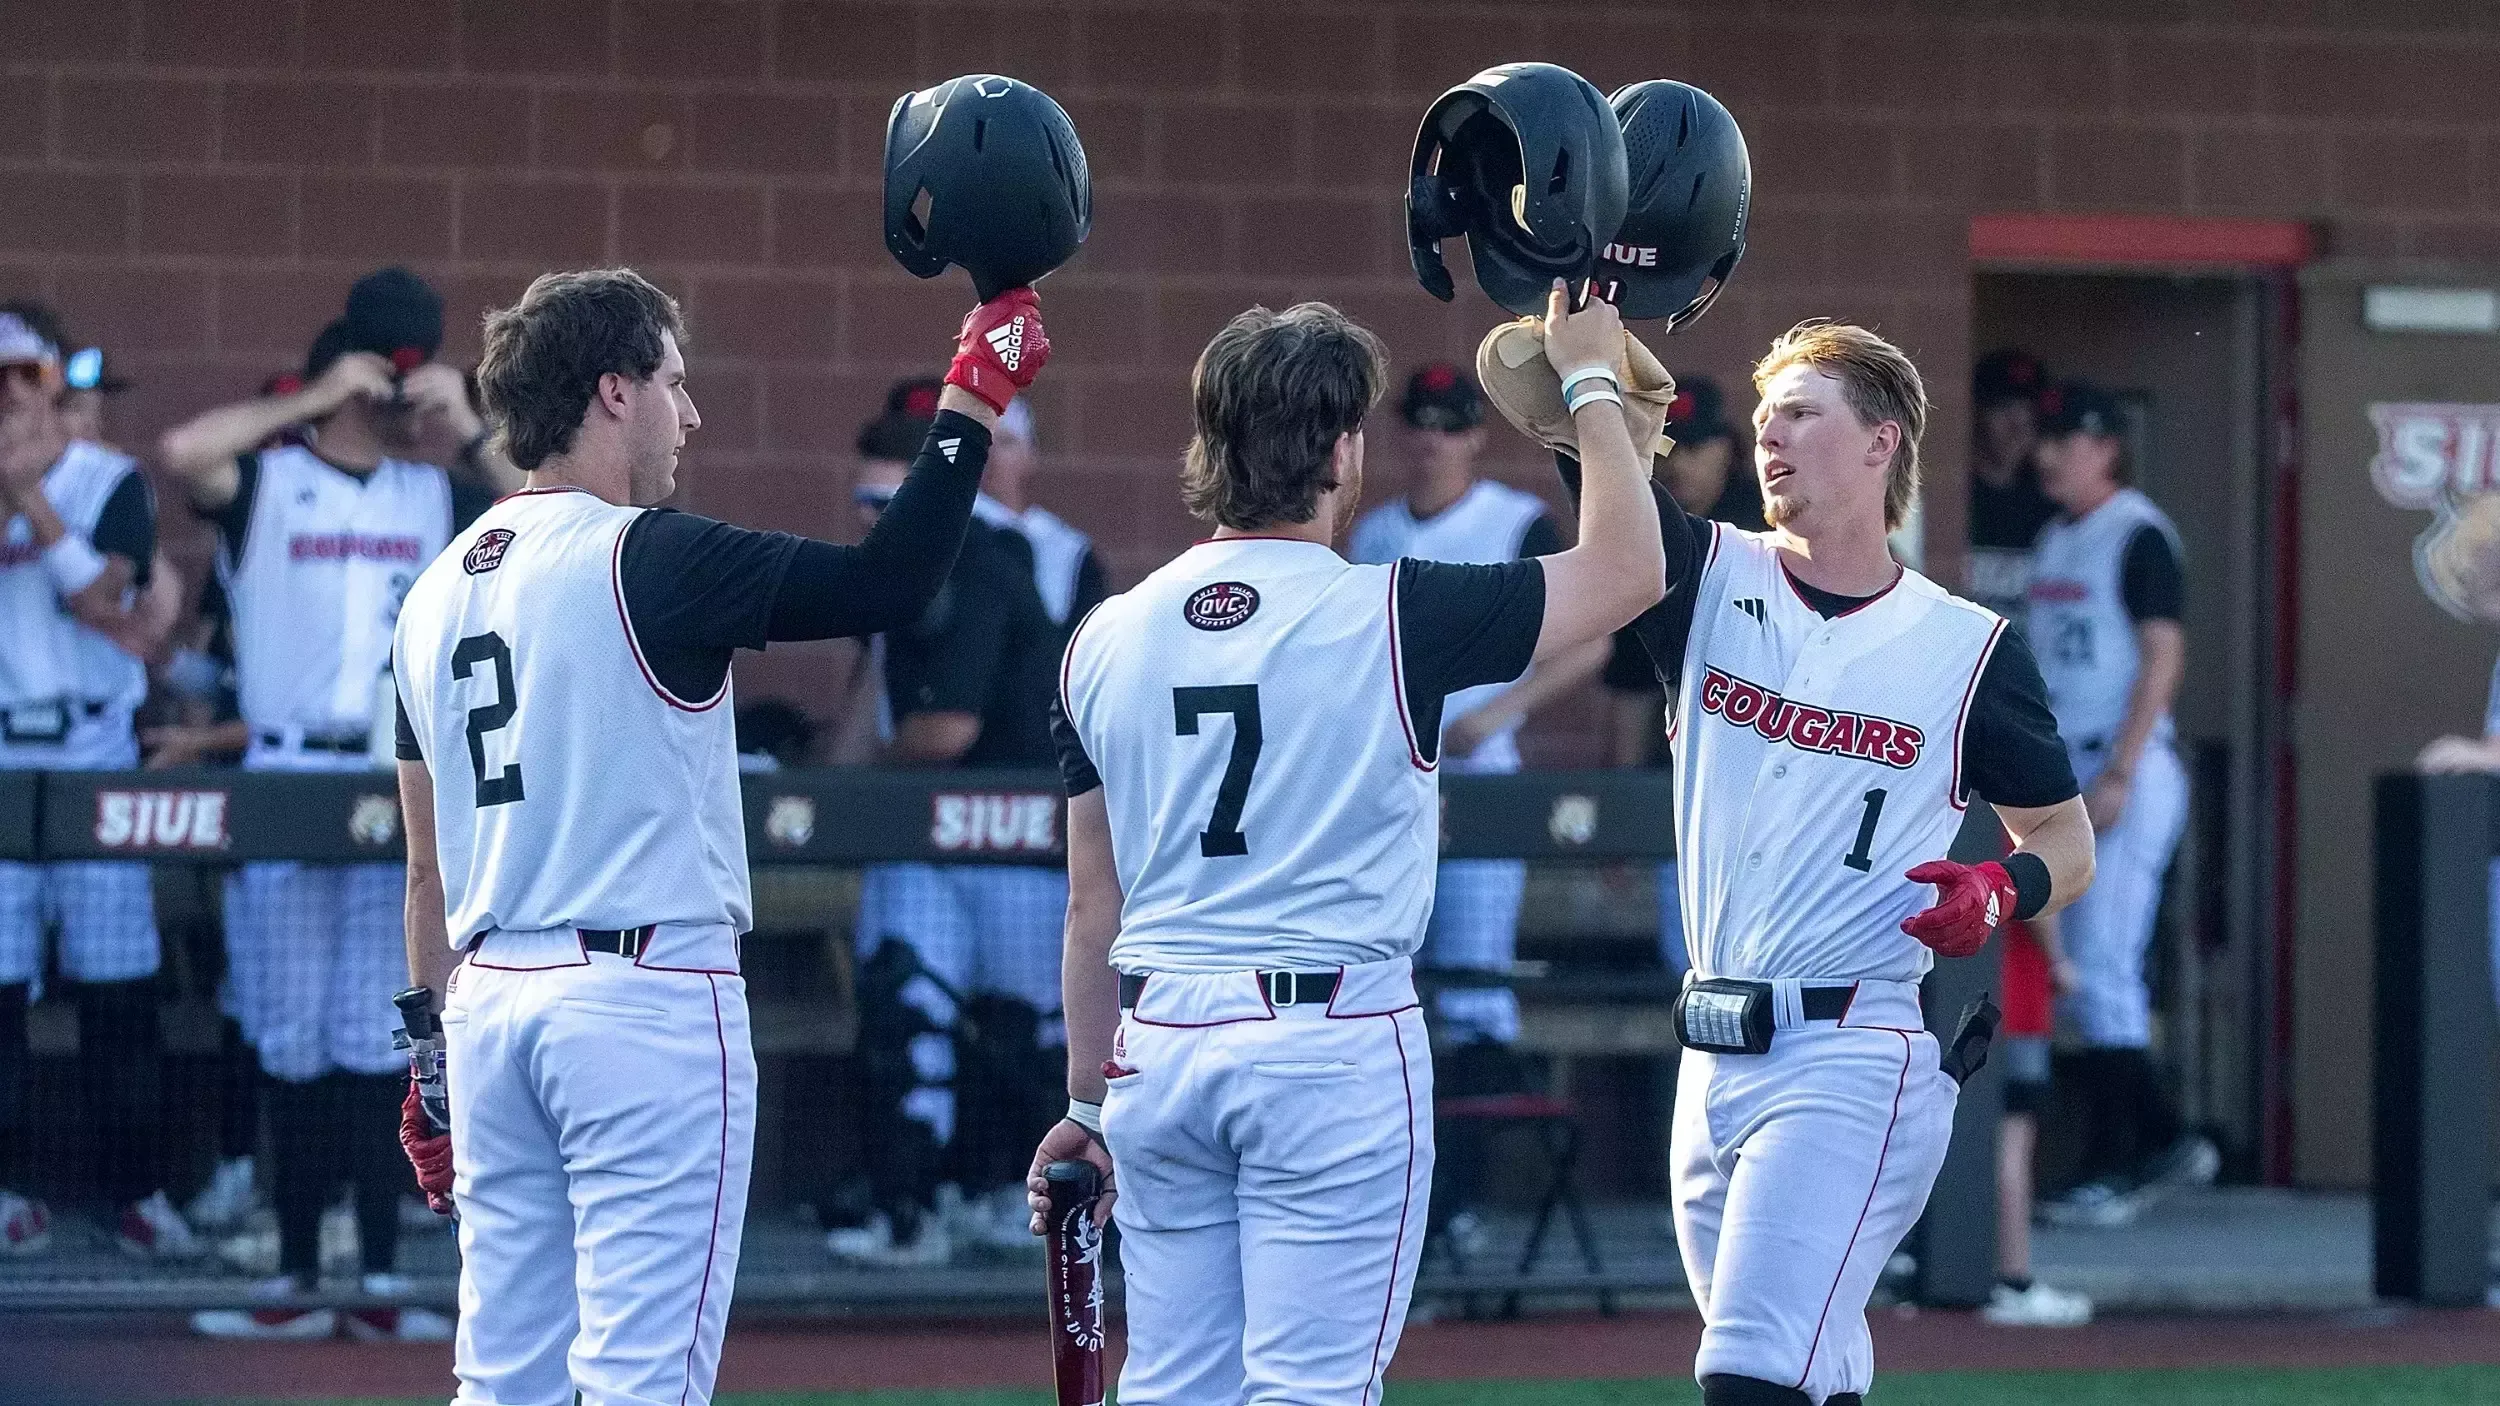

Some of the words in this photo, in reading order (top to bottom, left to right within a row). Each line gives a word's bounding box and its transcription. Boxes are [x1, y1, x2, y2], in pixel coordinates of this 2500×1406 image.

[1602, 242, 1657, 266] IUE
[1607, 281, 1618, 302] 1
[1008, 315, 1025, 371] adidas
[2380, 410, 2500, 495] SI
[1200, 596, 1245, 615] OVC
[451, 630, 525, 808] 2
[1700, 663, 1925, 770] COUGARS
[1172, 684, 1263, 858] 7
[96, 790, 228, 848] SIUE
[931, 794, 1059, 849] SIUE
[1844, 788, 1887, 872] 1
